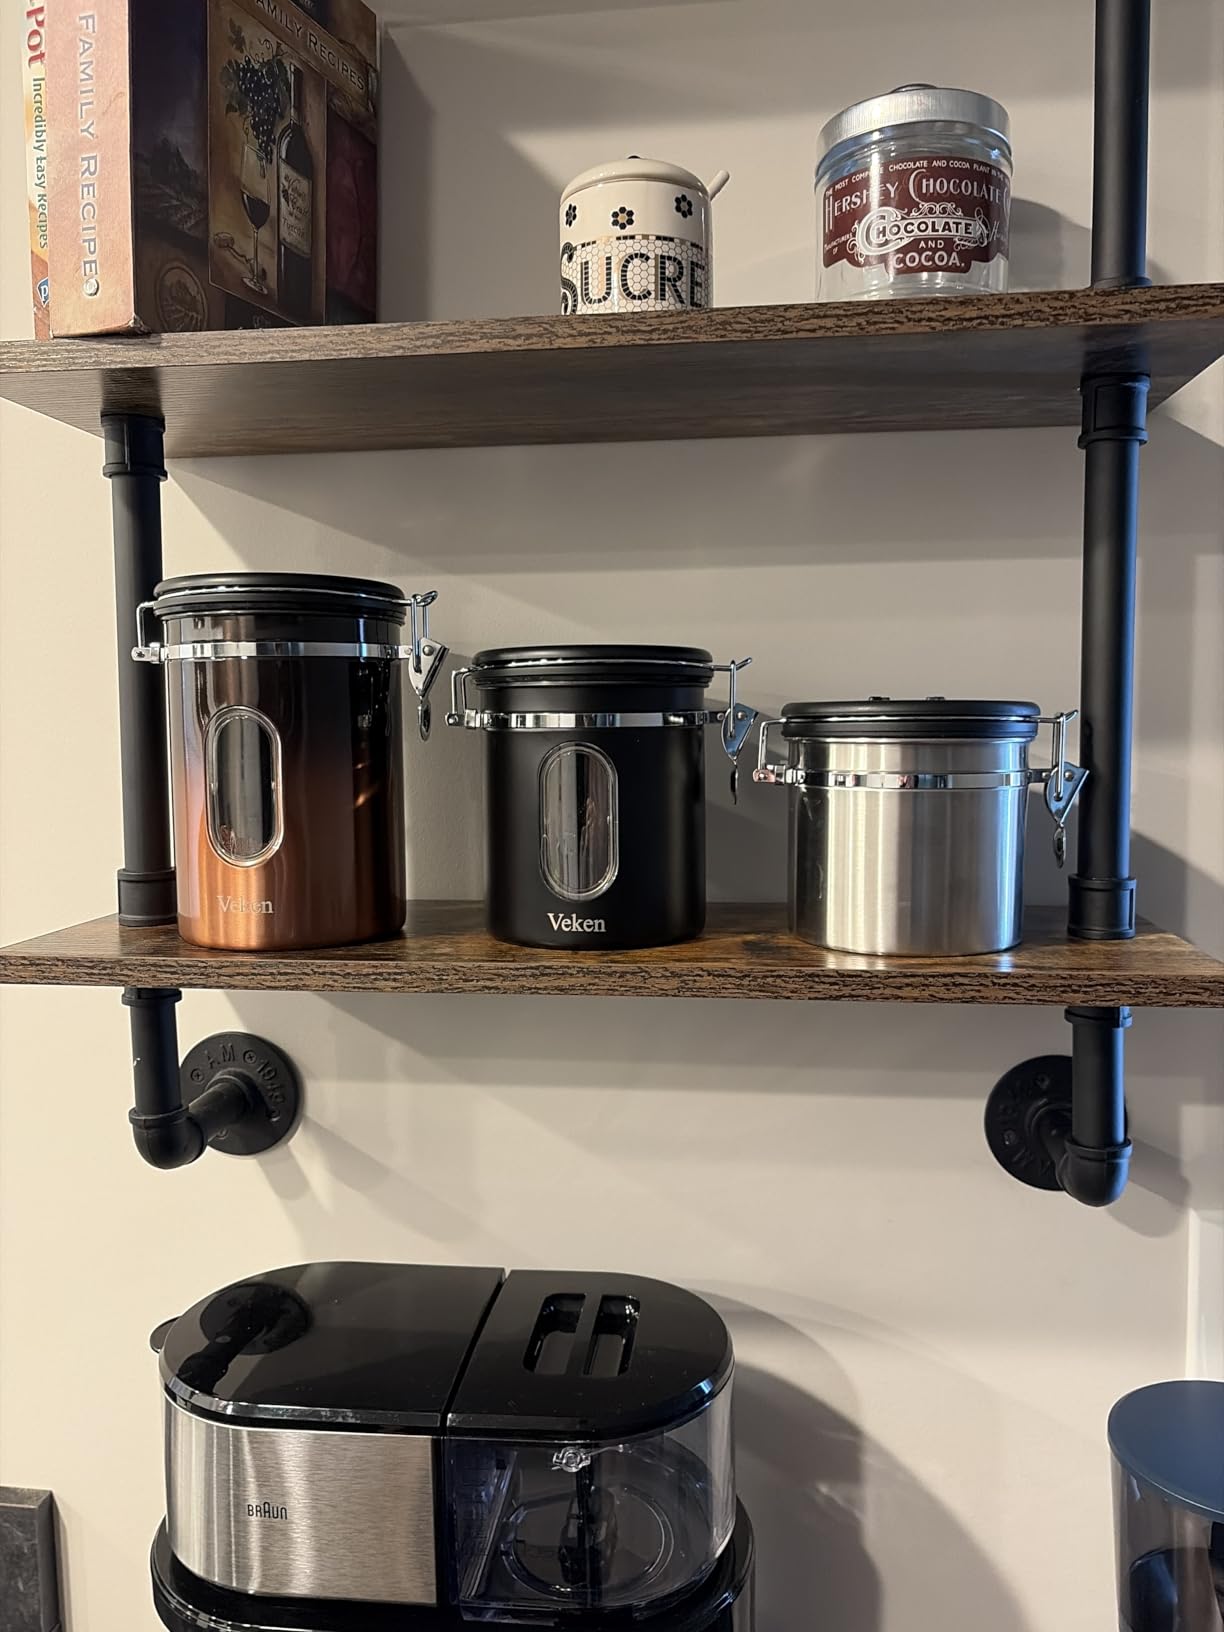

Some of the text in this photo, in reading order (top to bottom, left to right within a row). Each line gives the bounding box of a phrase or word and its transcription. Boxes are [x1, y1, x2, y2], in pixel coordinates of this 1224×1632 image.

[26, 5, 46, 69] Pot
[255, 0, 365, 91] AMILY RECIPES
[78, 13, 97, 140] FAMILY
[33, 76, 47, 152] Incredibly
[34, 155, 47, 189] Easy
[835, 178, 849, 192] MOST
[888, 160, 928, 173] CHOCOLATE
[931, 159, 947, 168] AND
[949, 160, 970, 170] COCOA
[973, 163, 990, 174] PLANT
[908, 168, 1001, 204] CHOCOLATE
[856, 206, 973, 256] CHOCOLATE
[918, 240, 945, 249] AND
[546, 912, 607, 933] Veken
